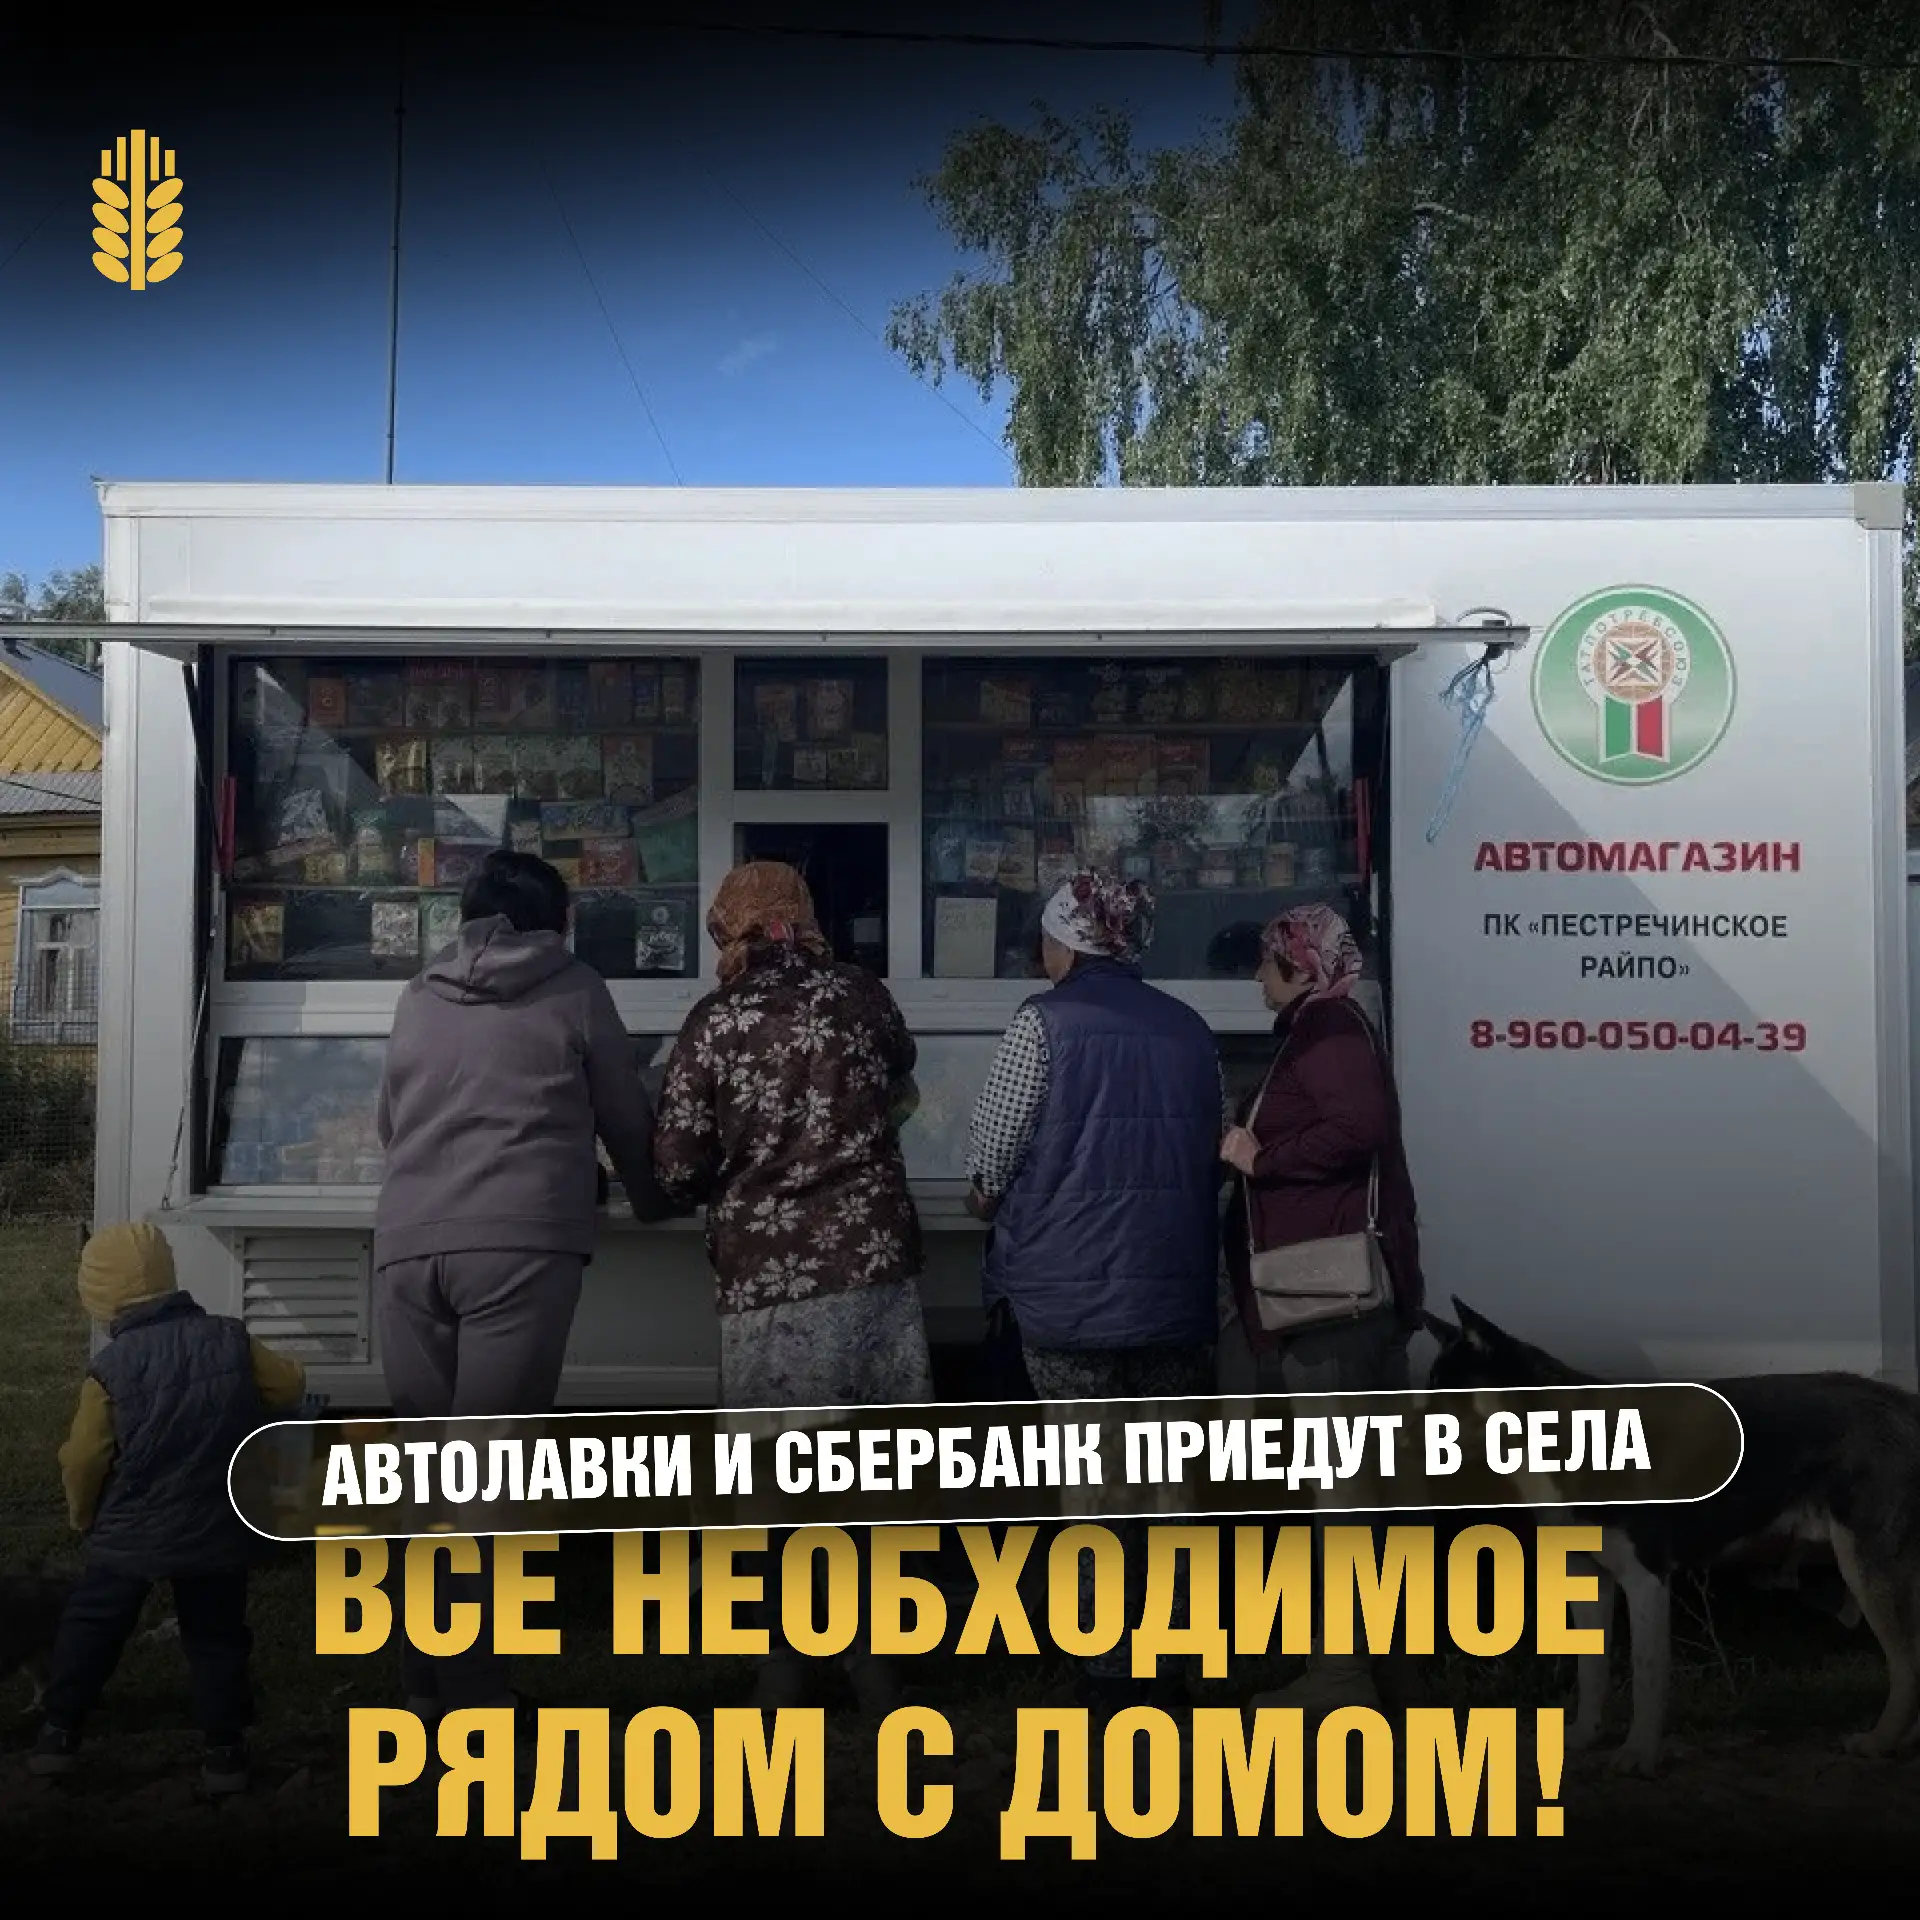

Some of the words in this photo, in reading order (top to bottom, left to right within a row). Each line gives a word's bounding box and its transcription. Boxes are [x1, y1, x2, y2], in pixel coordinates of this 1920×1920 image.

[1474, 841, 1800, 872] АВТОМАГАЗИН
[1484, 913, 1520, 936] ПК
[1529, 913, 1788, 938] «ПЕСТРЕЧИНСКОЕ
[1581, 951, 1690, 979] РАЙПО»
[1470, 1019, 1807, 1051] 8-960-050-04-39
